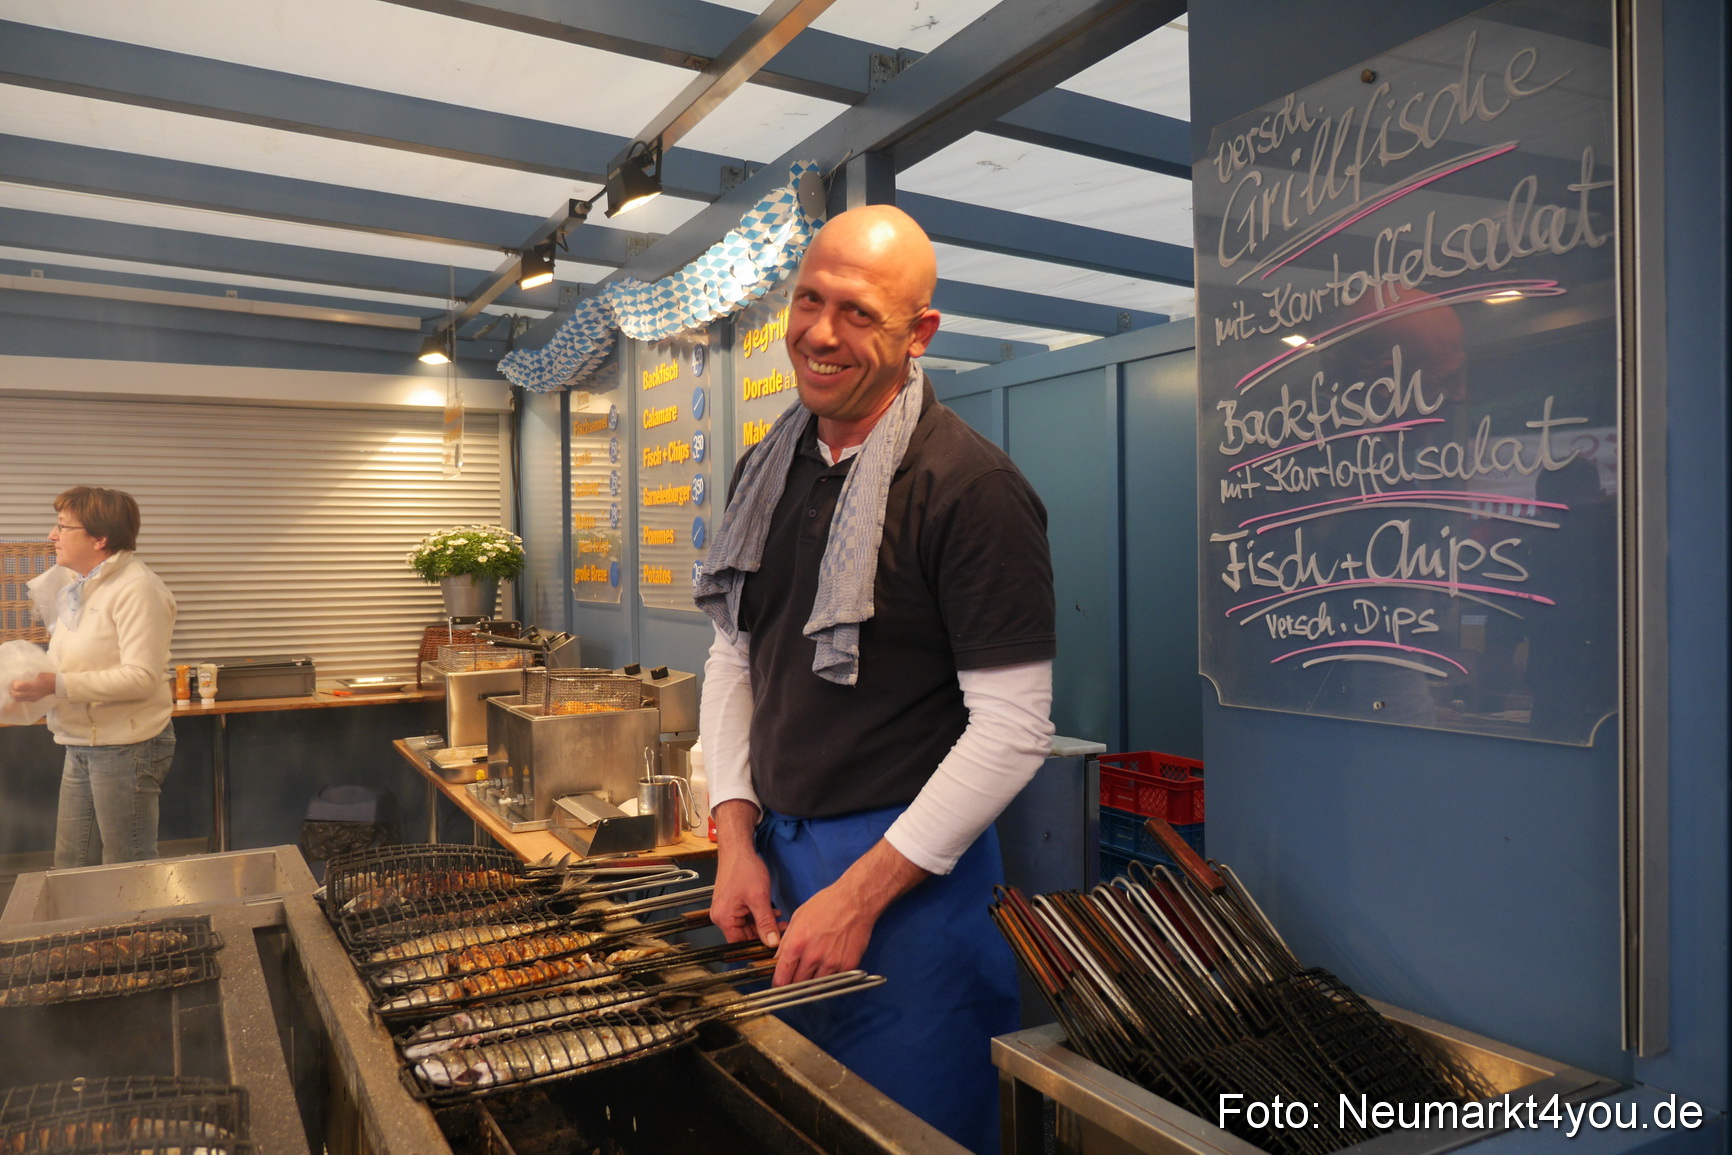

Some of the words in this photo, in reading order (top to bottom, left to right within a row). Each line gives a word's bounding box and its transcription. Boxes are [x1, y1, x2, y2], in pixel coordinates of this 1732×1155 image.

[1213, 92, 1325, 183] versch.
[1218, 30, 1572, 268] Grillfische
[1215, 301, 1256, 346] mit
[1259, 146, 1614, 334] Kartoffelsalat
[643, 359, 679, 391] Backfisch
[743, 368, 783, 401] Dorade
[643, 405, 678, 430] Calamare
[1217, 345, 1444, 456] Backfisch
[643, 446, 662, 468] Fisch
[668, 440, 690, 464] Chips
[1220, 472, 1261, 504] mit
[1263, 395, 1589, 500] Kartoffelsalat
[643, 483, 692, 506] Garnelenburger
[643, 526, 675, 545] Pommes
[643, 564, 672, 584] Potatos
[1210, 528, 1339, 593] Fisch
[1366, 519, 1529, 597] Chips
[1354, 599, 1439, 646] Dips
